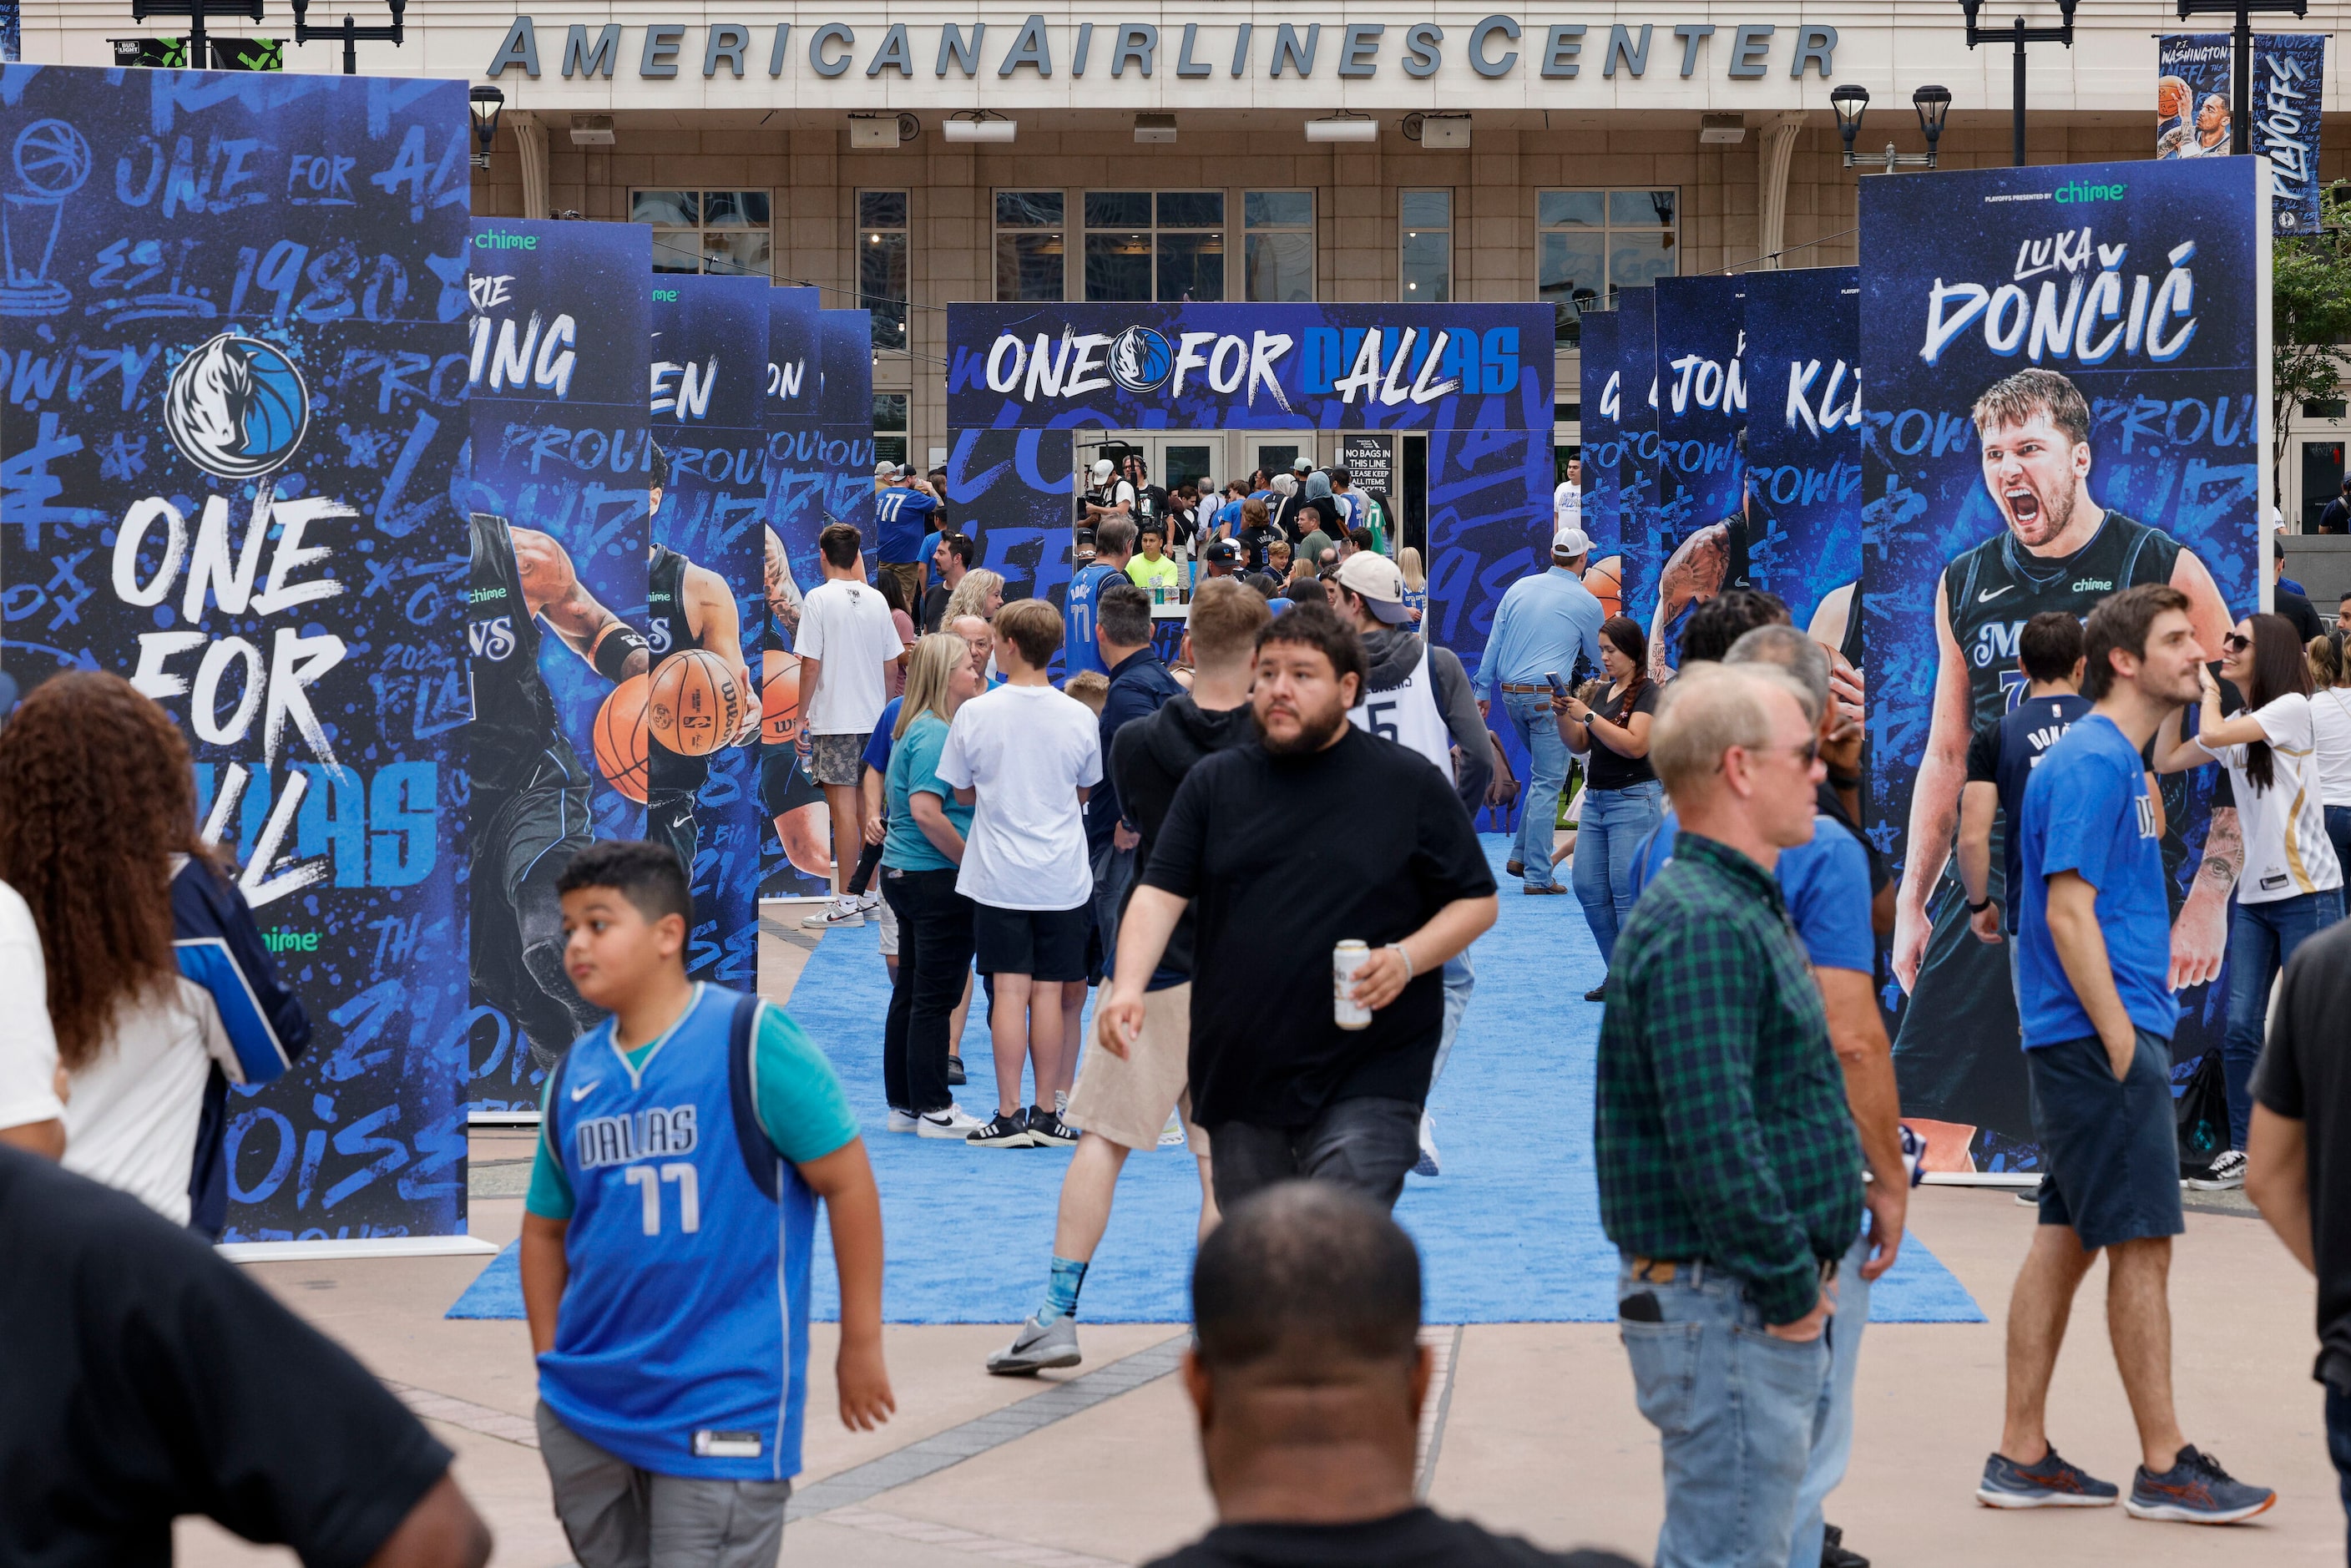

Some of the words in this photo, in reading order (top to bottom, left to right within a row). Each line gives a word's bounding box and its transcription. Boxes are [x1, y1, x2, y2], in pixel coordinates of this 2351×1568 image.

[2161, 46, 2228, 65] WASHINGTON
[2257, 54, 2310, 200] PLAYOFFS
[2055, 180, 2127, 204] chime
[475, 229, 540, 250] chime
[2014, 227, 2093, 281] LUKA
[1920, 240, 2198, 367] DONČIĆ
[987, 323, 1116, 402] ONE
[1172, 330, 1294, 416] FOR
[1334, 326, 1460, 406] ALL
[1346, 449, 1358, 458] NO
[1359, 449, 1382, 458] BAGS
[1383, 449, 1391, 458] IN
[1349, 459, 1368, 468] THIS
[1369, 459, 1387, 468] LINE
[881, 493, 908, 523] 77
[113, 477, 361, 625] ONE
[2072, 579, 2112, 594] chime
[1070, 604, 1090, 643] 77
[129, 628, 348, 788] FOR
[576, 1103, 698, 1170] DALLAS
[624, 1162, 700, 1236] 77
